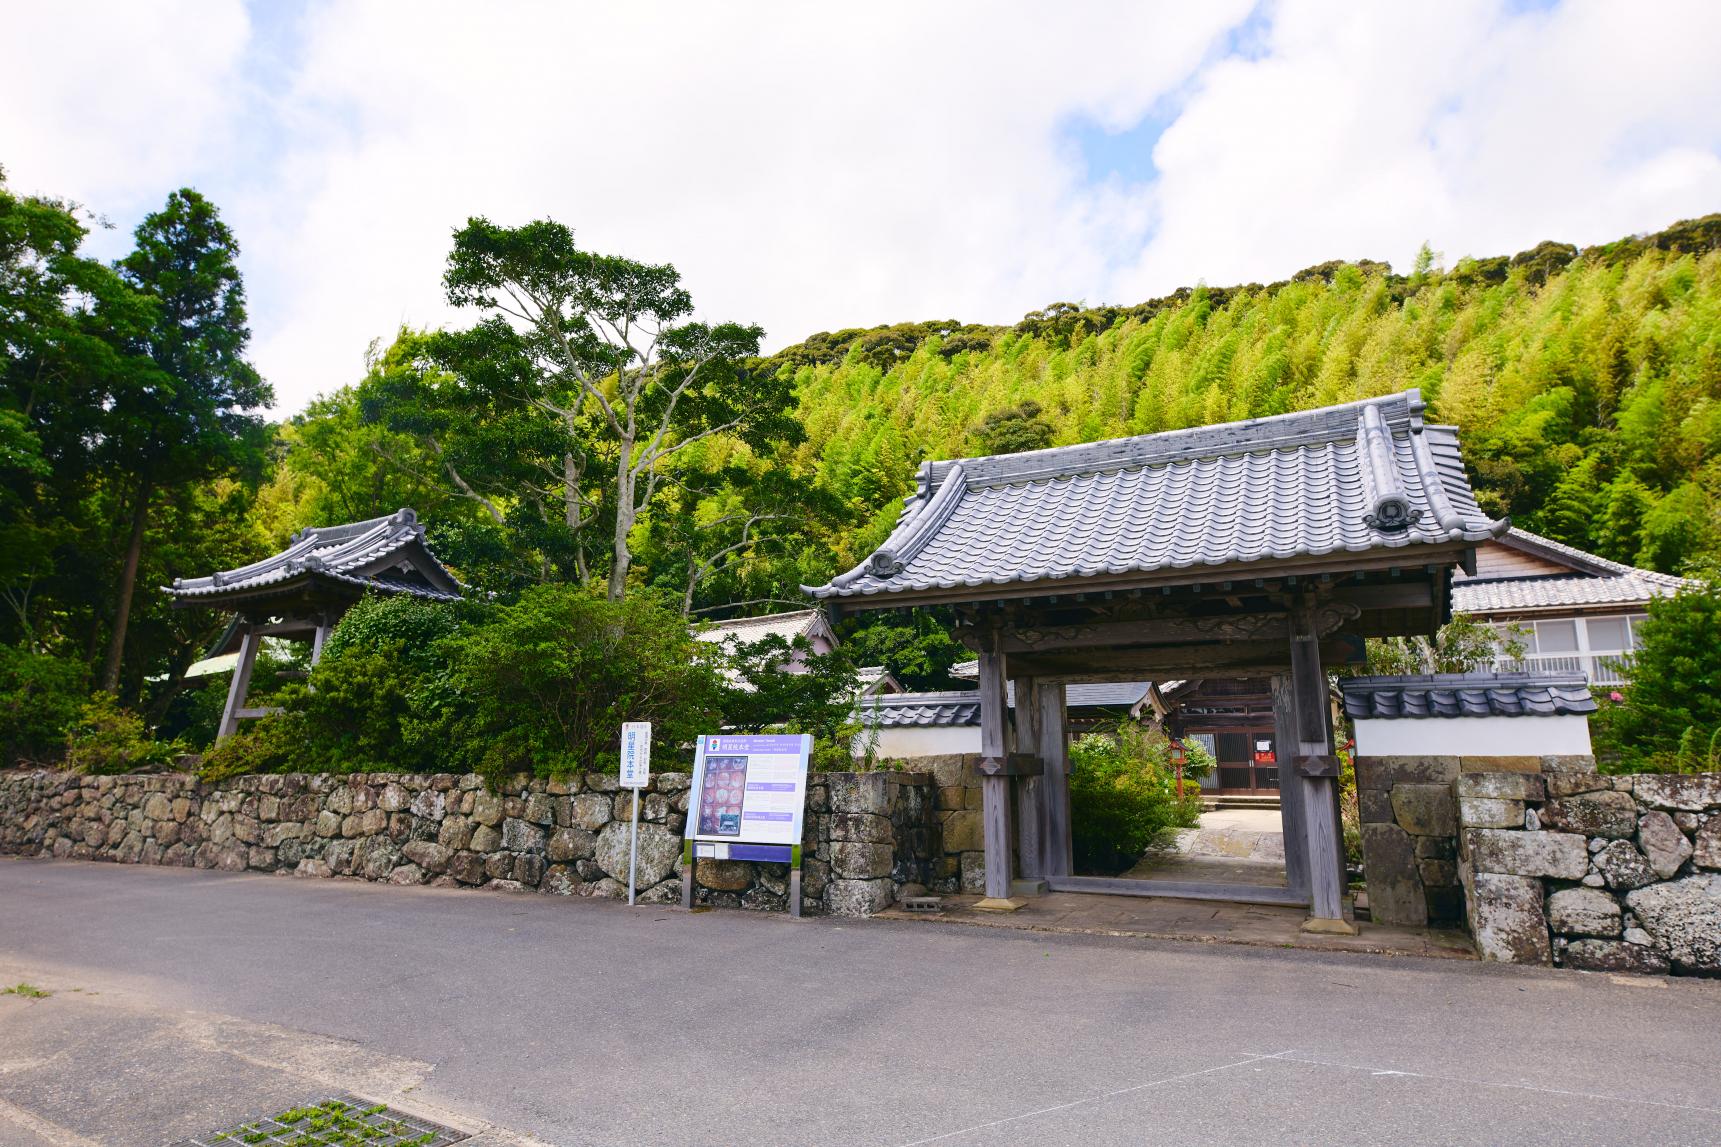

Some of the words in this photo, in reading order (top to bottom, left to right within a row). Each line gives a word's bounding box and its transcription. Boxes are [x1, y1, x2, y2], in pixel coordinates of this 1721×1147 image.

[626, 732, 636, 778] 明星院本堂
